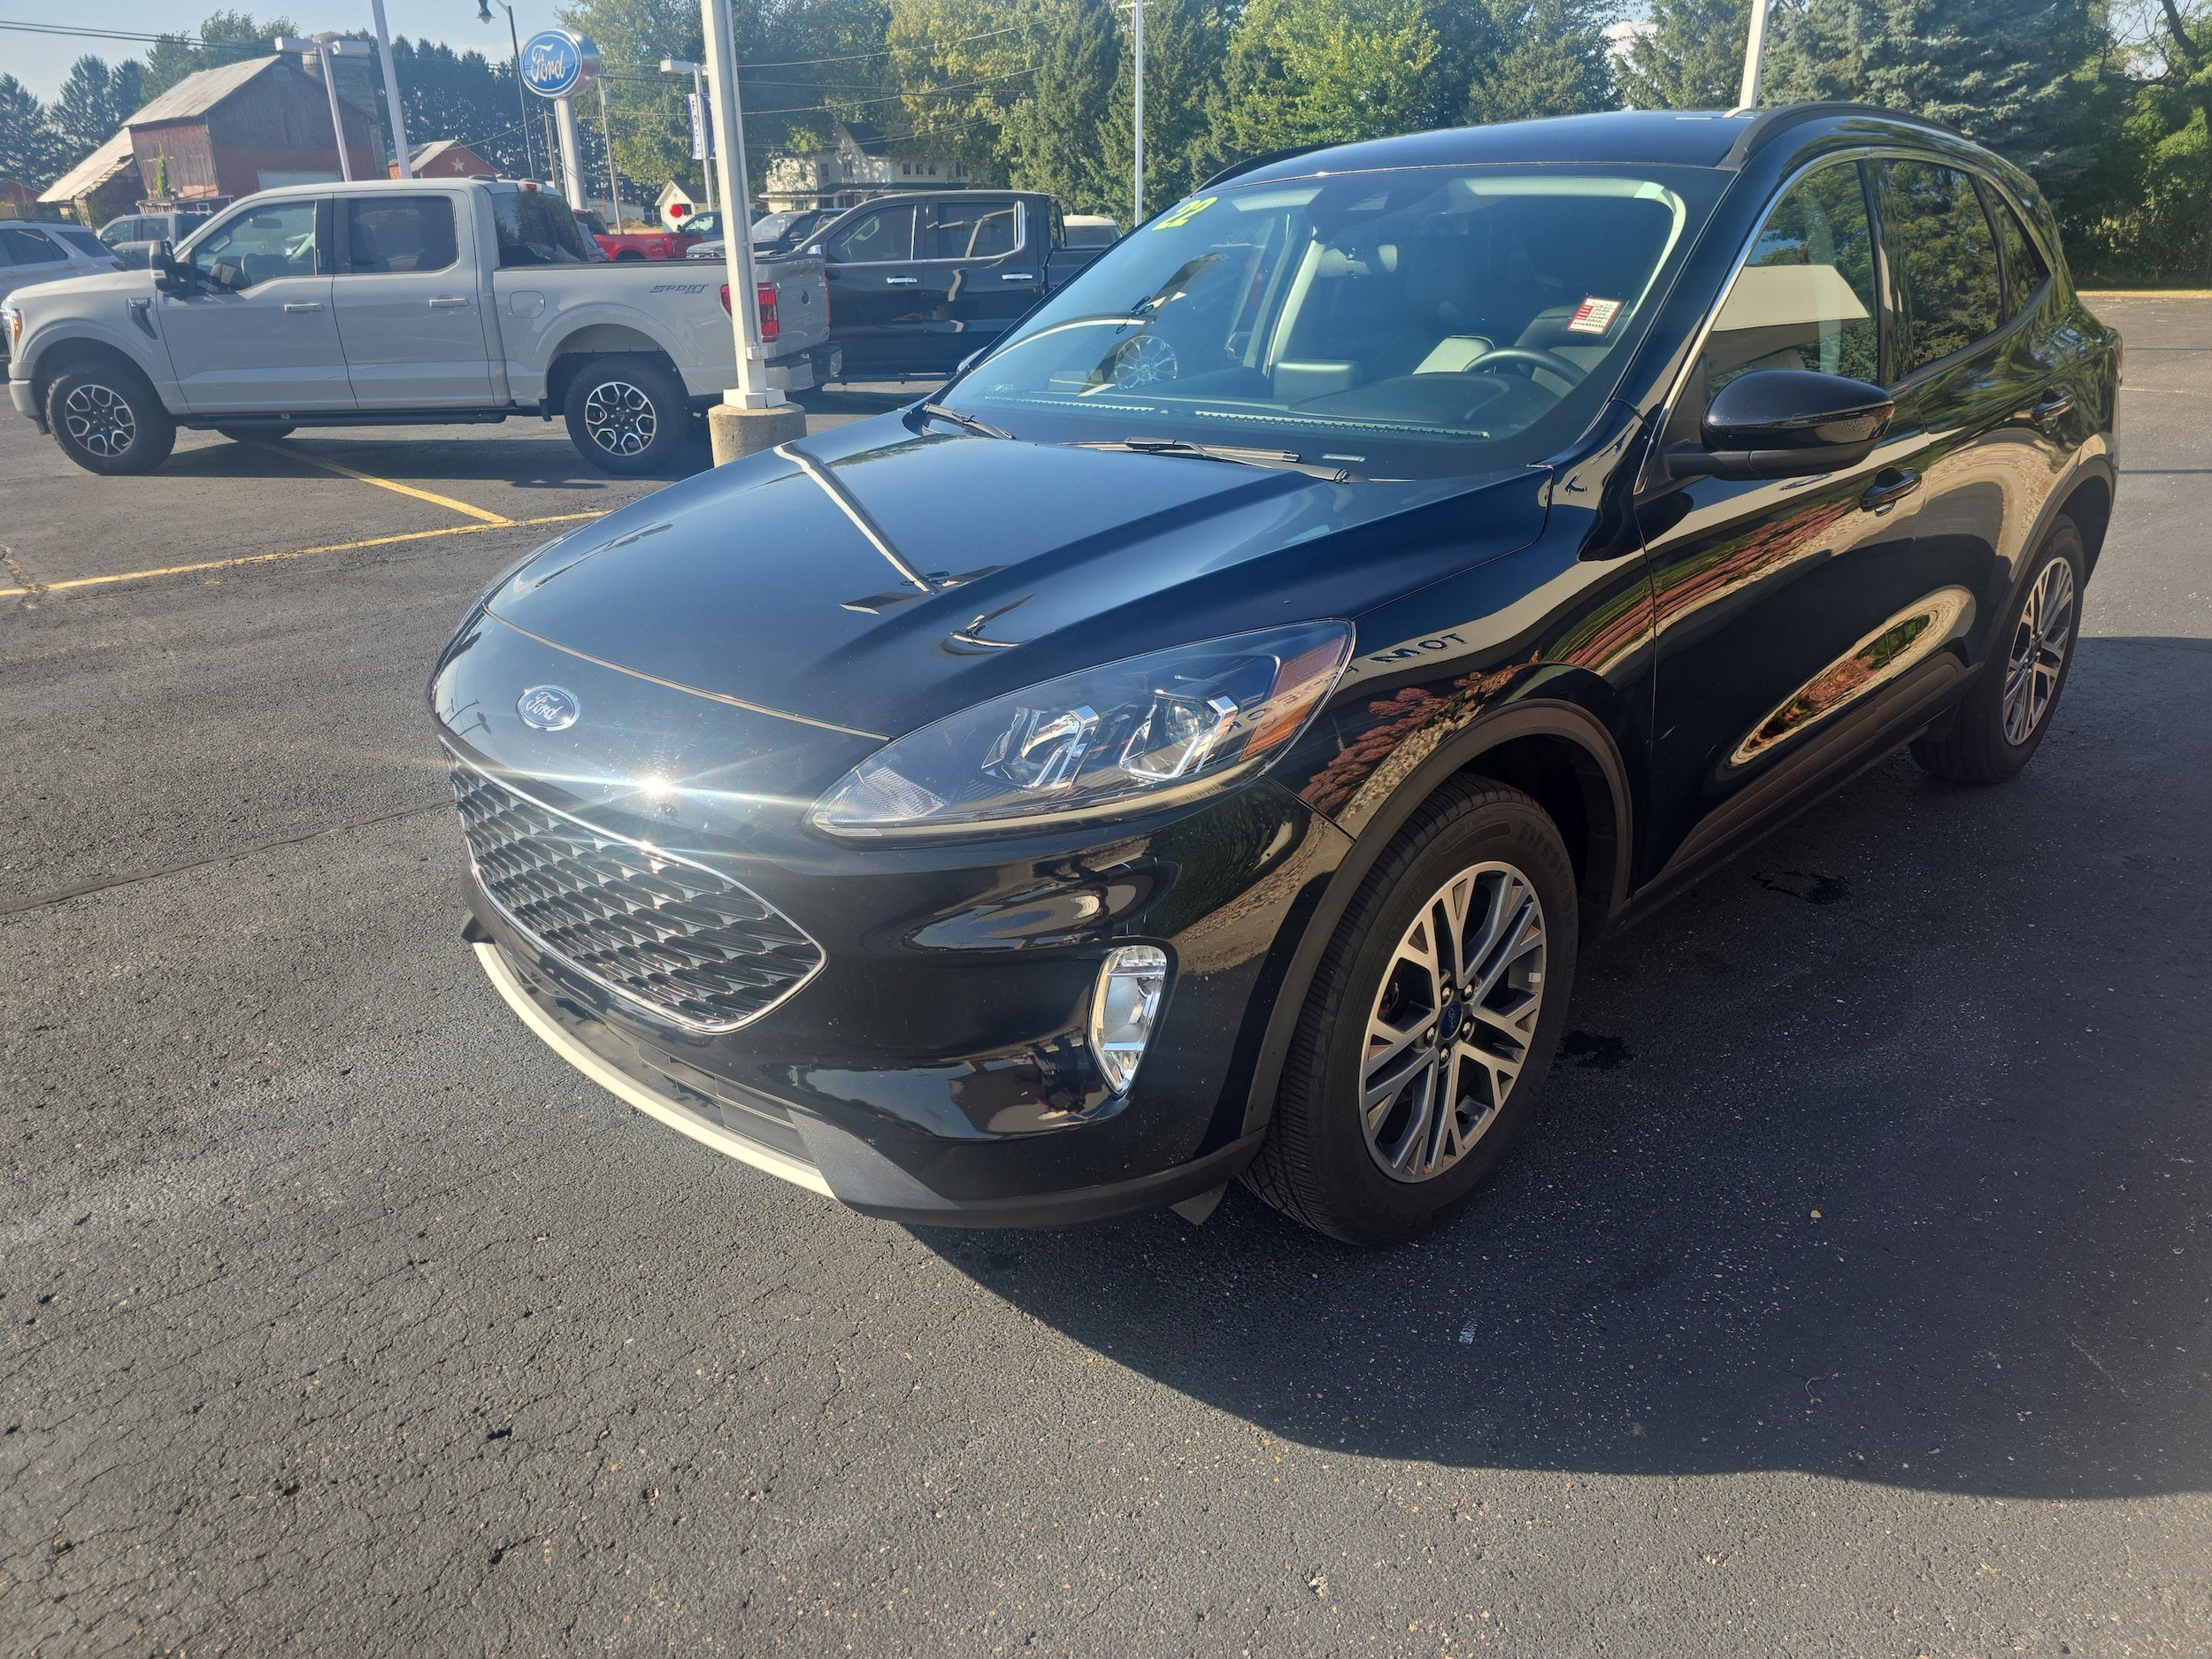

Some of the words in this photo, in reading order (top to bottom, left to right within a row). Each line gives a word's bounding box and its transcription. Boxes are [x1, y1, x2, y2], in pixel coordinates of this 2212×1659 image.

[531, 42, 566, 83] Ford
[1151, 196, 1218, 231] 22
[649, 284, 709, 293] SPORT
[526, 691, 564, 720] Ford
